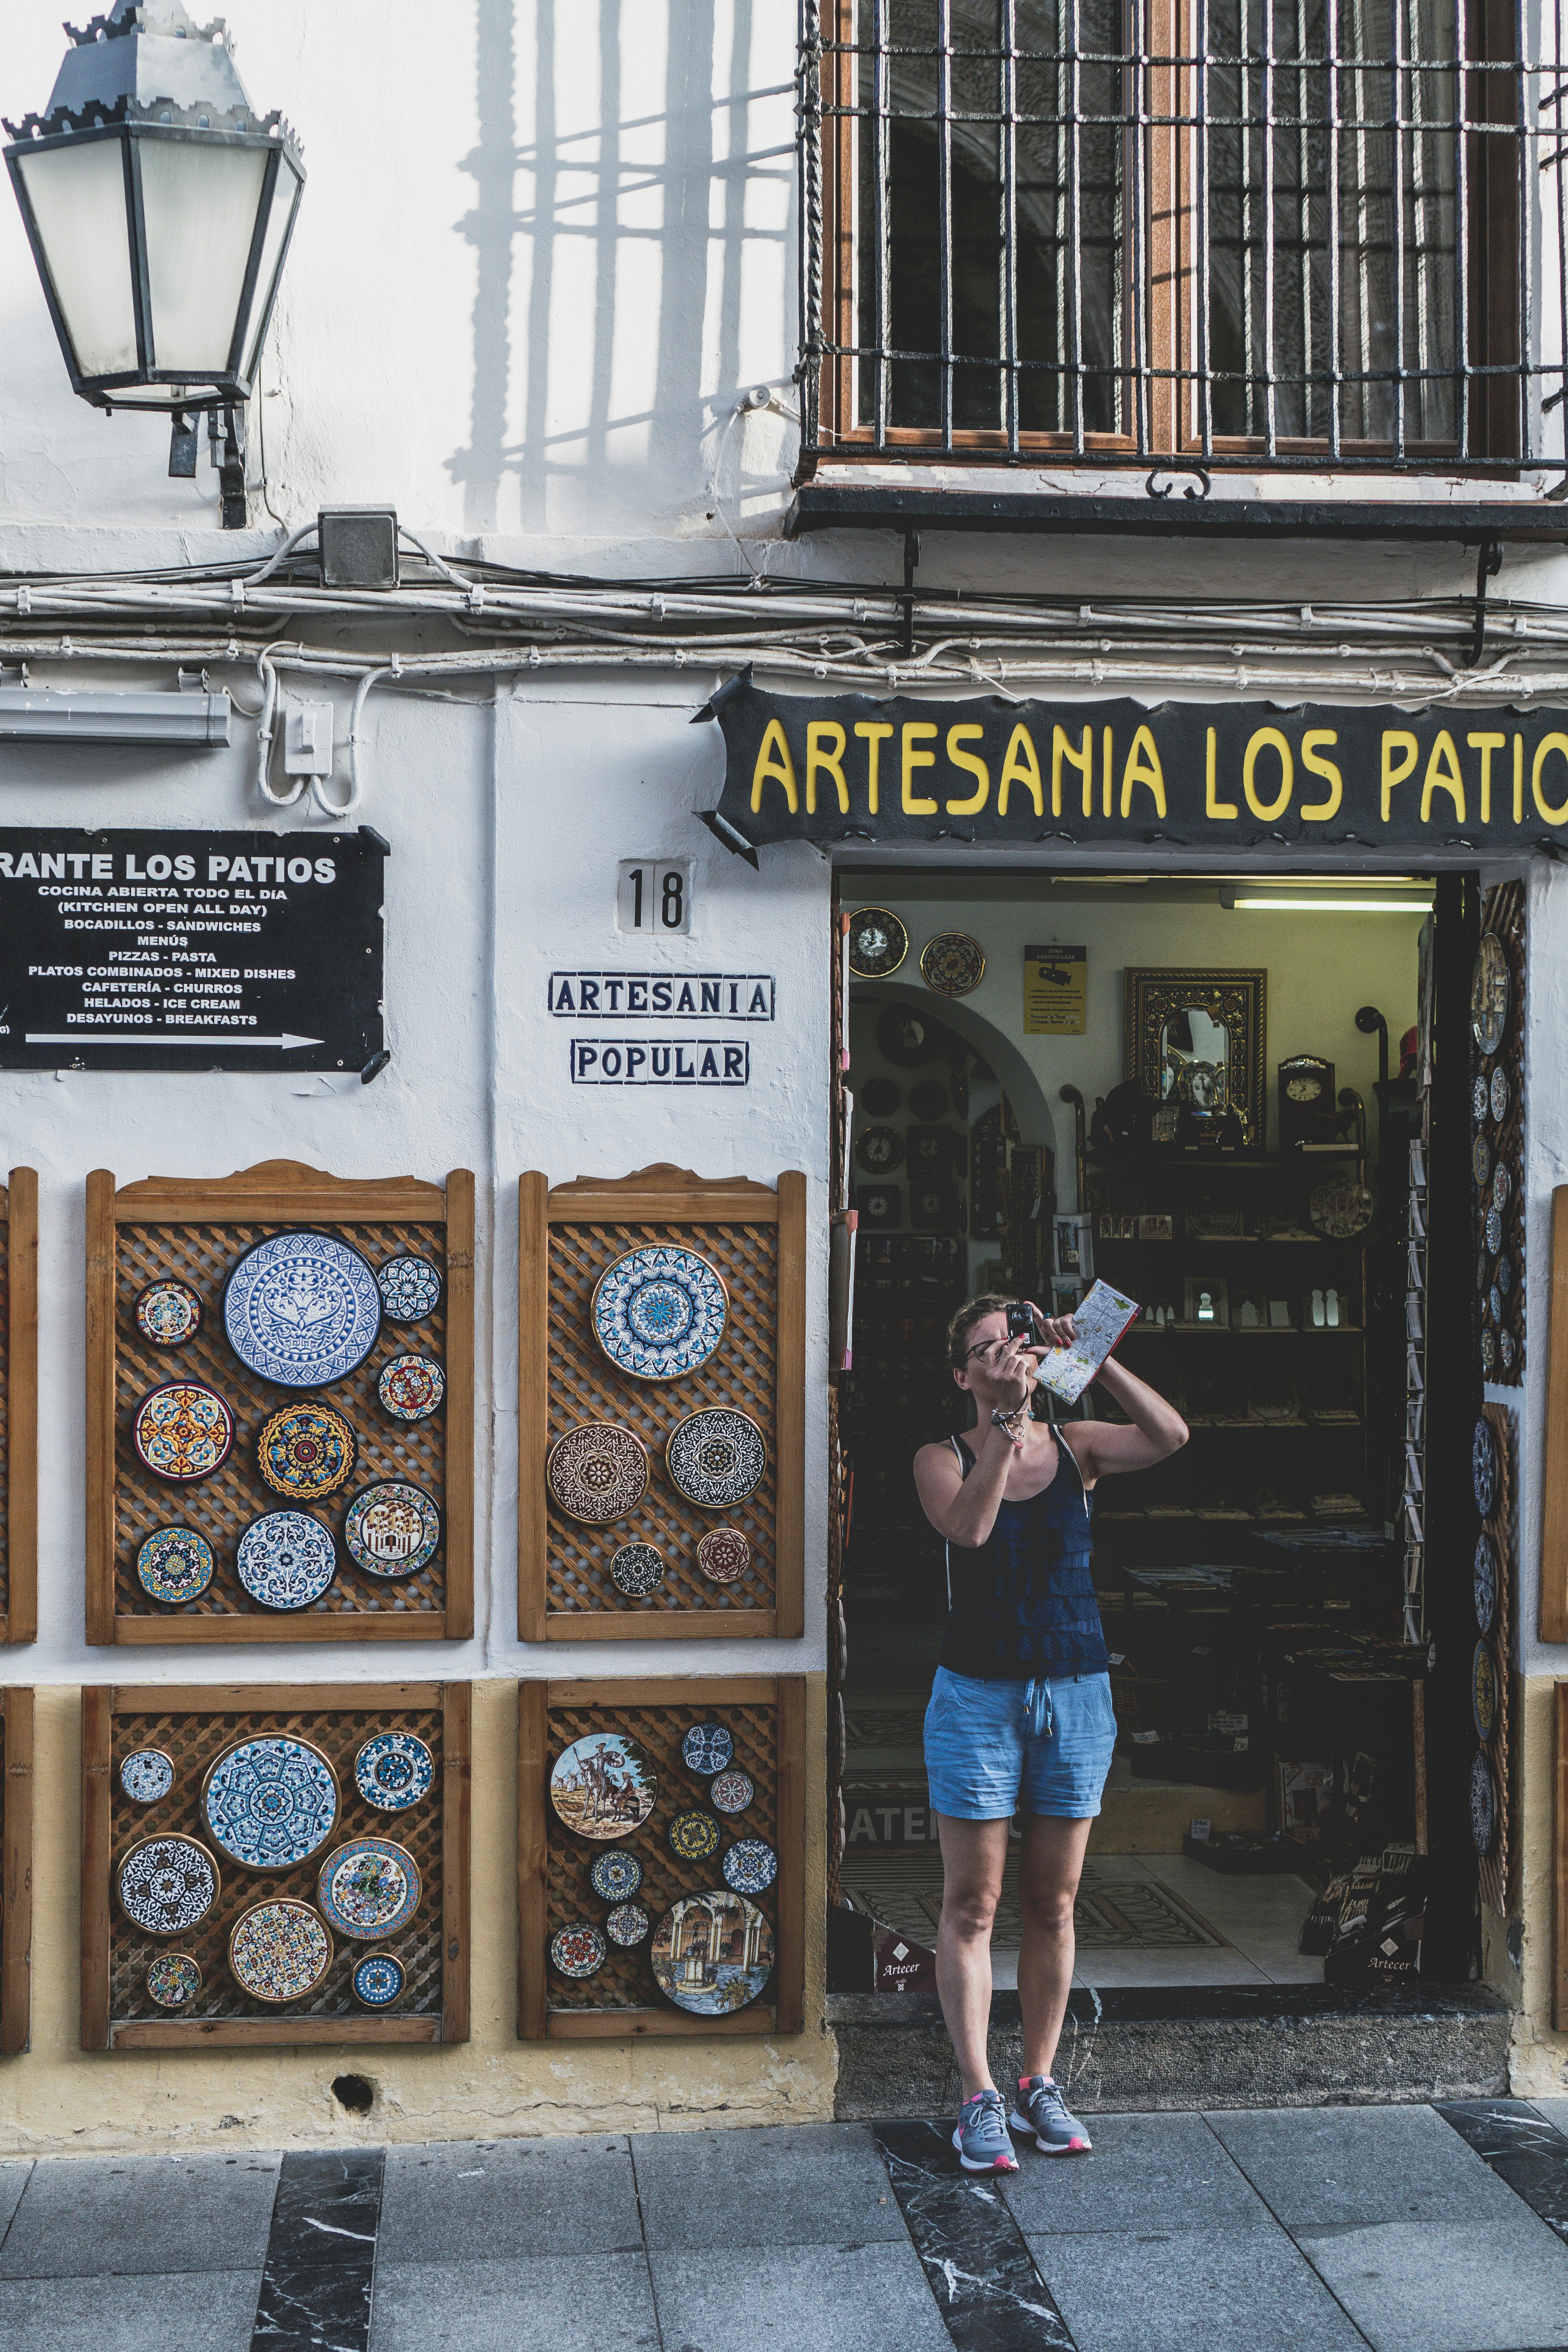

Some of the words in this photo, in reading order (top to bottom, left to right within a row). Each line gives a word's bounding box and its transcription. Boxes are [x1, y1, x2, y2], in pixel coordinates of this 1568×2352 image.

[750, 718, 1167, 818] ARTESANIA
[1206, 726, 1343, 822] LOS
[1381, 729, 1568, 825] PATIO
[0, 852, 113, 879] RANTE
[126, 854, 196, 880] LOS
[209, 855, 336, 884] PATIOS
[38, 886, 103, 896] COCINA
[107, 887, 180, 897] ABIERTA
[183, 888, 230, 898] TODO
[234, 889, 255, 899] EL
[628, 867, 684, 928] 18
[58, 902, 138, 914] (KITCHEN
[143, 903, 189, 913] OPEN
[193, 904, 225, 914] ALL
[229, 905, 267, 917] DAY)
[64, 919, 155, 930] BOCADILLOS
[167, 921, 261, 932] SANDWICHES
[137, 935, 188, 946] MENÚS
[109, 951, 160, 961] PIZZAS
[172, 952, 217, 962] PASTA
[29, 966, 83, 976] PLATOS
[87, 967, 183, 977] COMBINADOS
[195, 968, 240, 978] MIXED
[244, 969, 296, 979] DISHES
[82, 981, 162, 993] CAFETERÍA
[173, 984, 243, 994] CHURROS
[555, 980, 768, 1013] ARTESANIA
[84, 998, 151, 1008] HELADOS
[163, 999, 187, 1008] ICE
[191, 999, 240, 1009] CREAM
[67, 1013, 153, 1024] DESAYUNOS
[165, 1014, 257, 1025] BREAKFASTS
[577, 1047, 743, 1078] POPULAR
[883, 1963, 920, 1976] Artecer
[1367, 1957, 1411, 1971] Artecer
